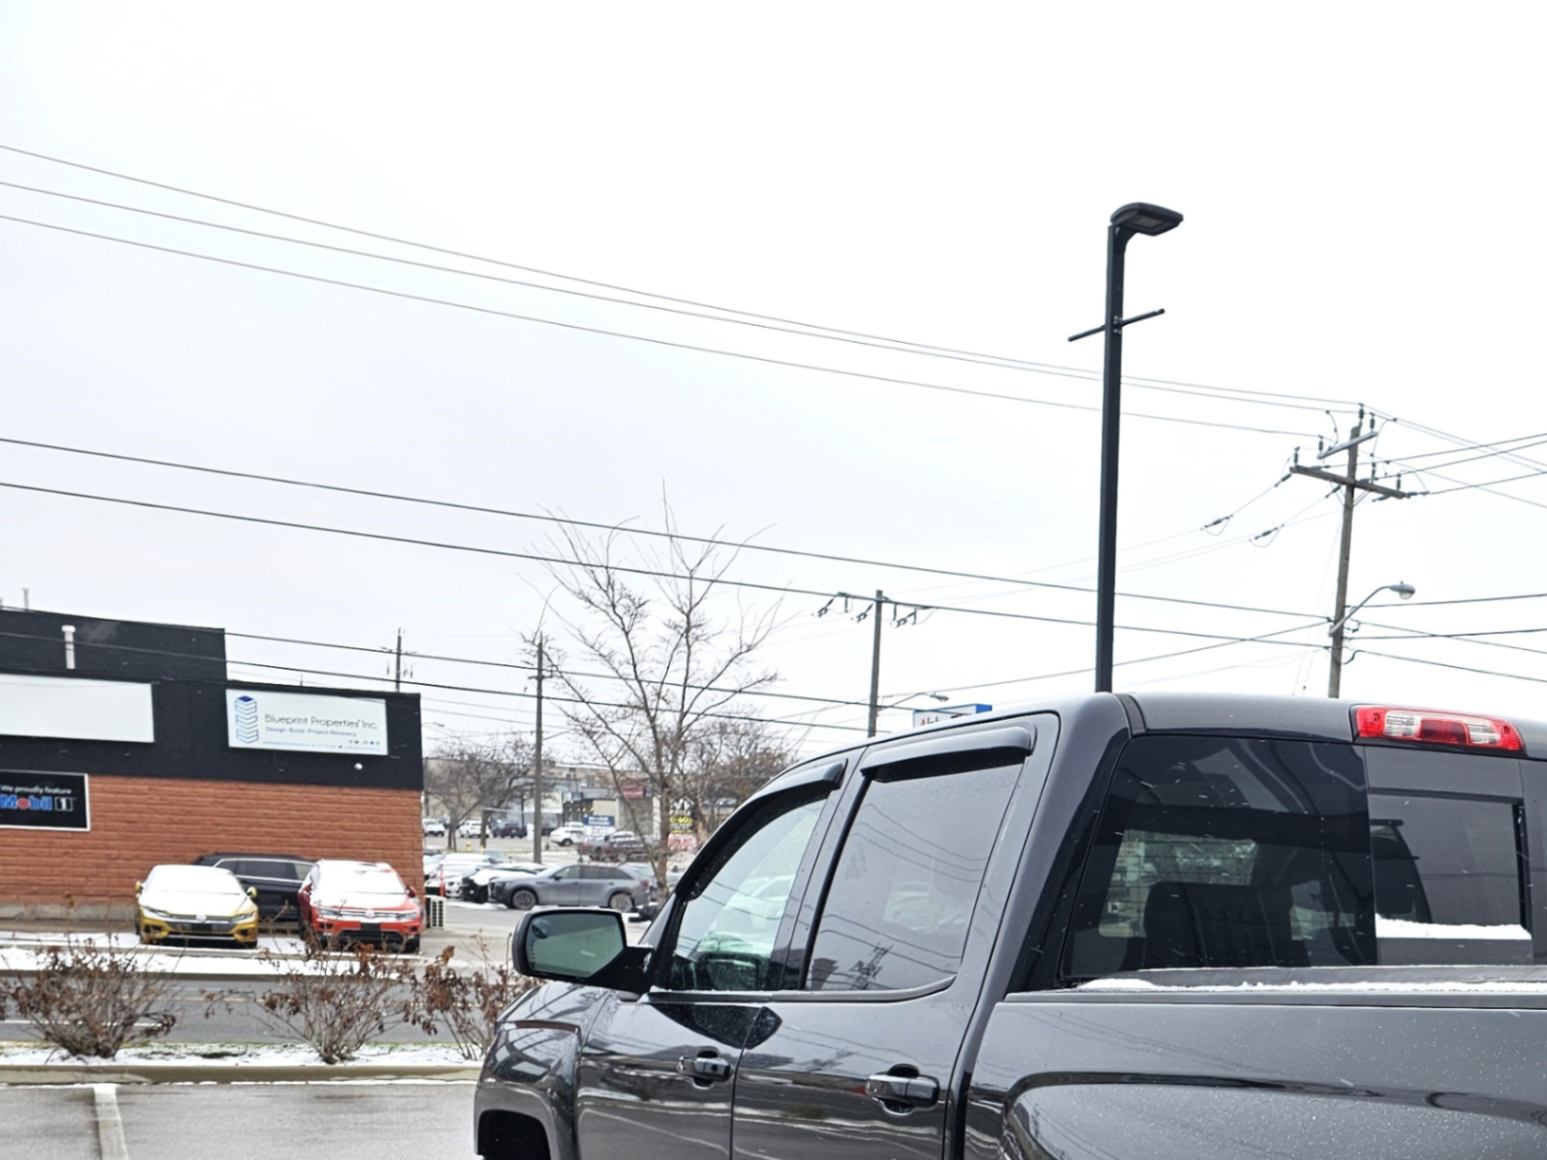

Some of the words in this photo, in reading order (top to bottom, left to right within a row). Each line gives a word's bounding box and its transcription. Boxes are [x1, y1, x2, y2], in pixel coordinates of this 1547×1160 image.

[264, 713, 308, 726] Blueprint
[15, 786, 43, 795] proudly
[44, 786, 72, 795] feature
[0, 794, 53, 811] Mobil
